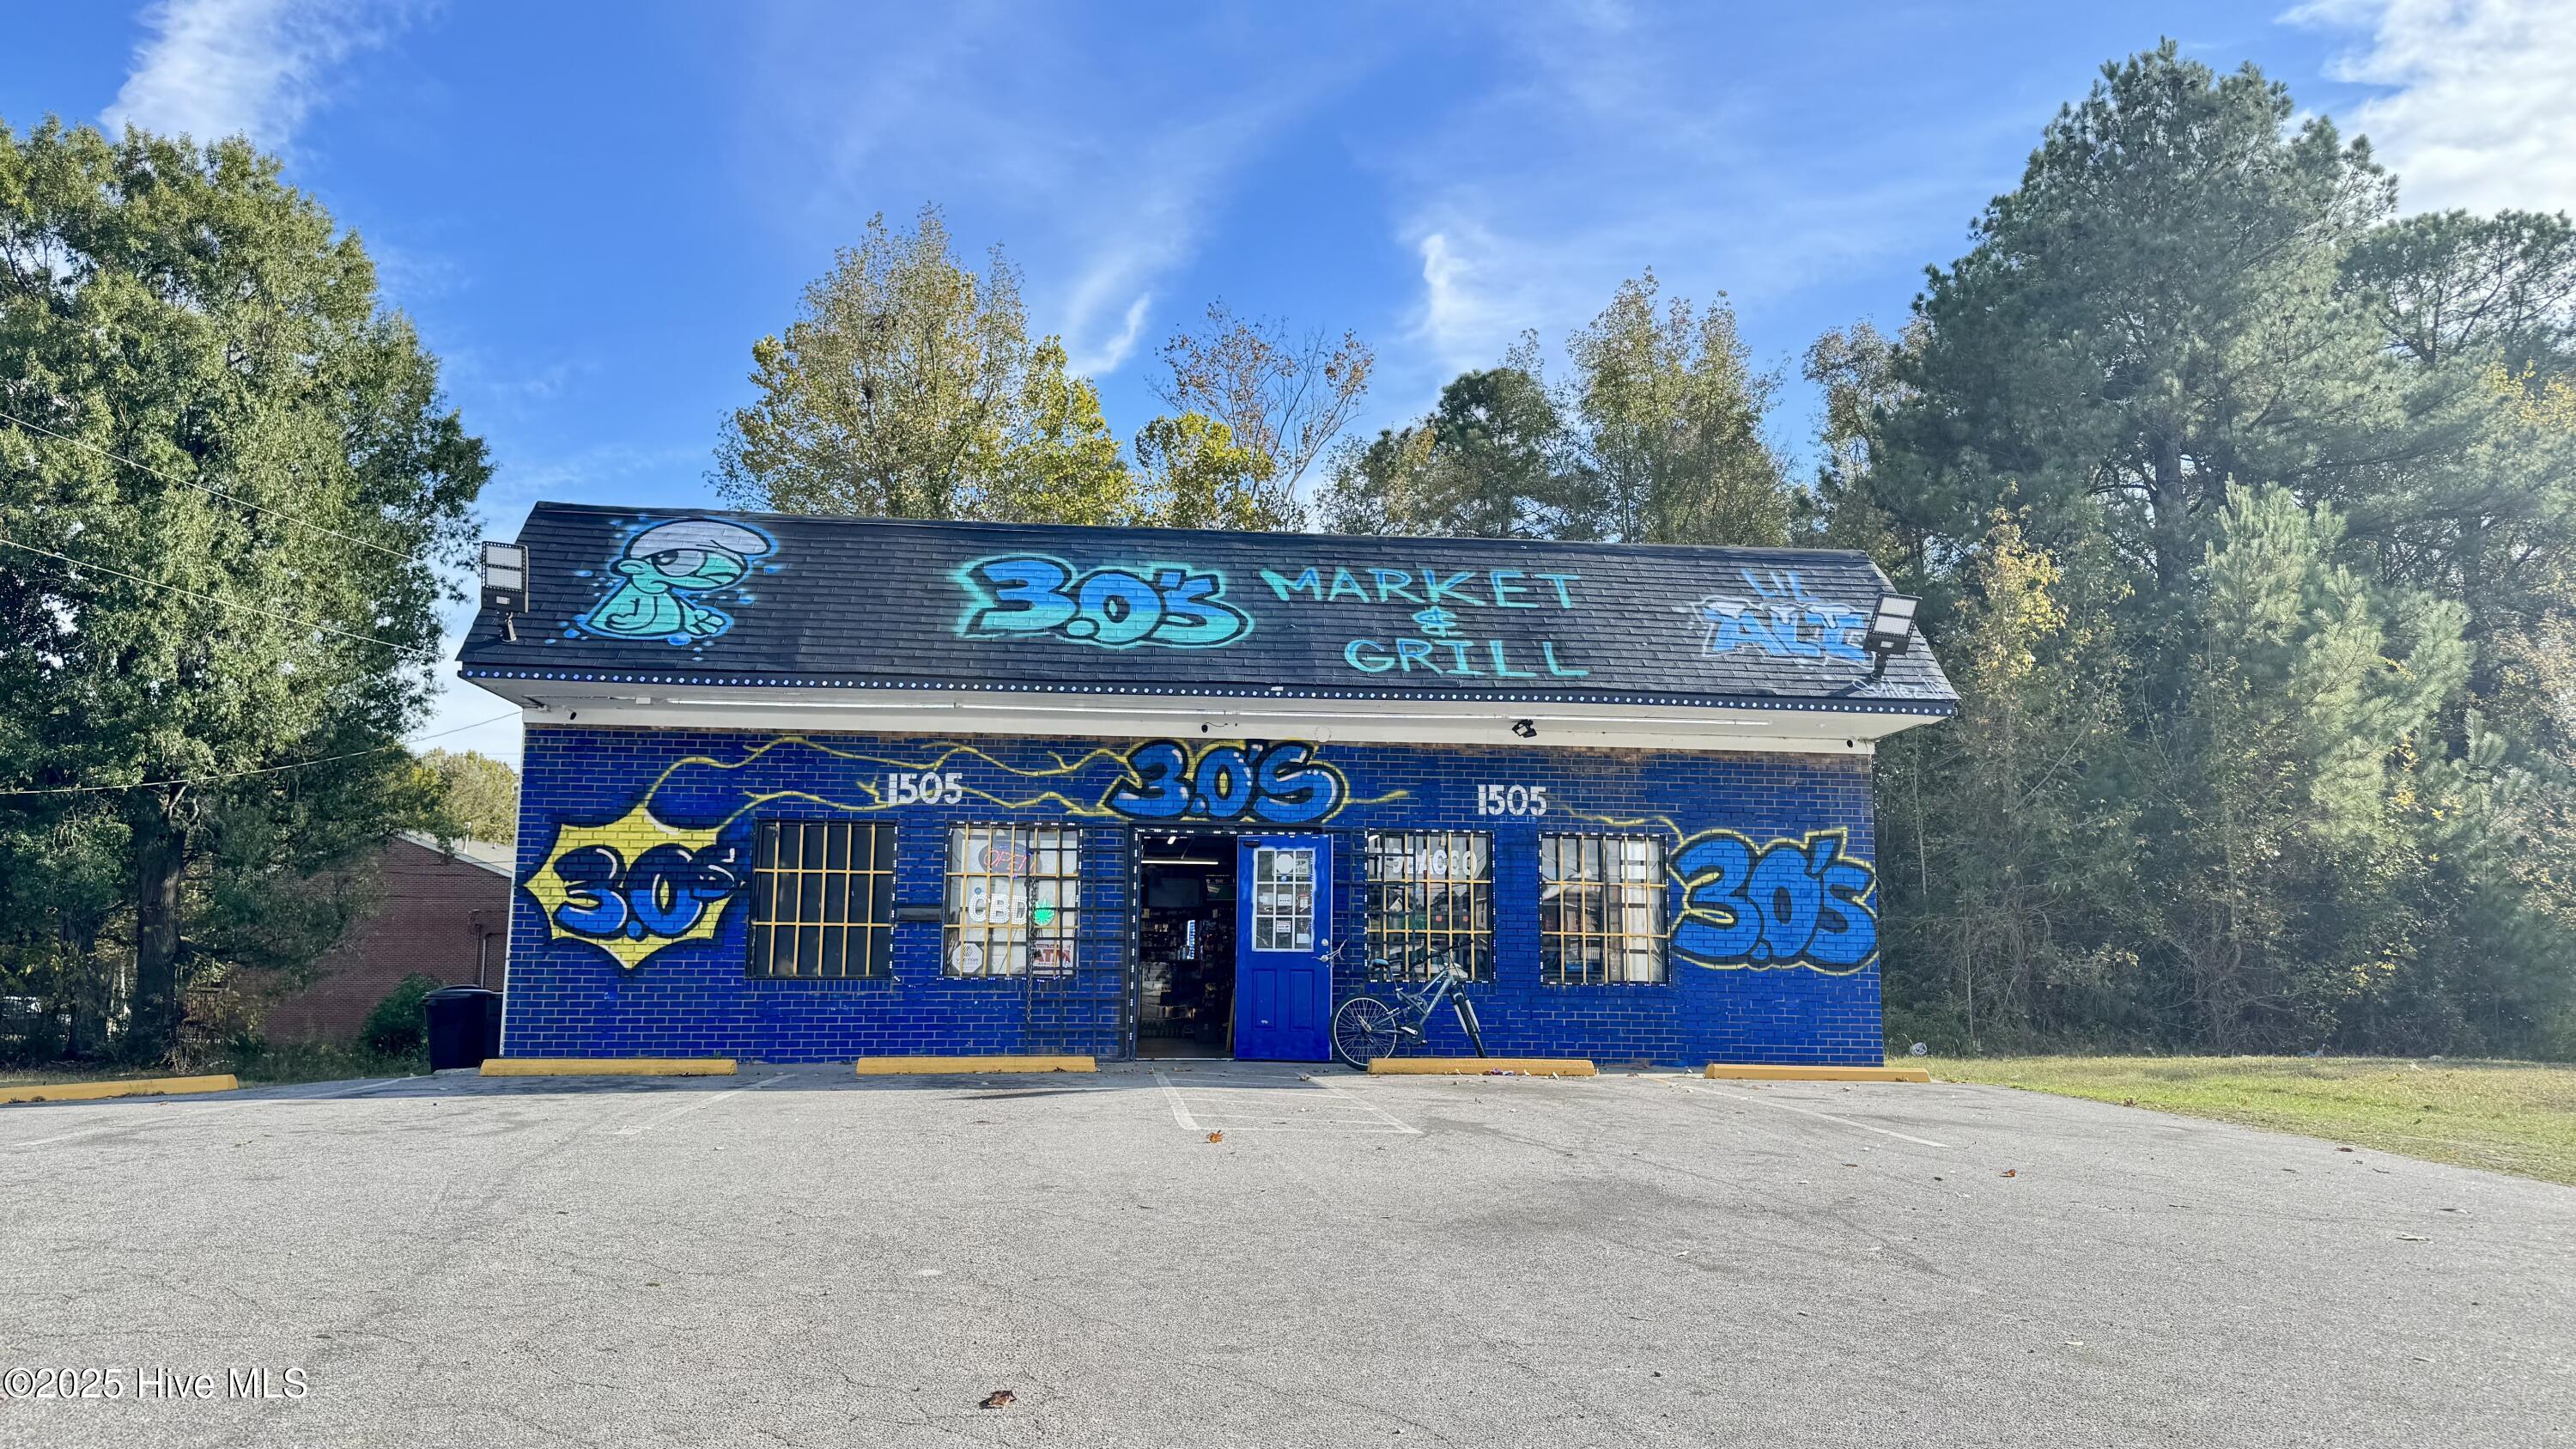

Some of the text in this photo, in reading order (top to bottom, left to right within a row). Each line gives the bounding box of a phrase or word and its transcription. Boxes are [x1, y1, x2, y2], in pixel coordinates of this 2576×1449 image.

[1260, 567, 1581, 609] MARKET
[1344, 638, 1589, 678] GRILL
[888, 772, 963, 804] 1505
[1478, 784, 1546, 816] 1505
[969, 892, 1029, 925] CBD
